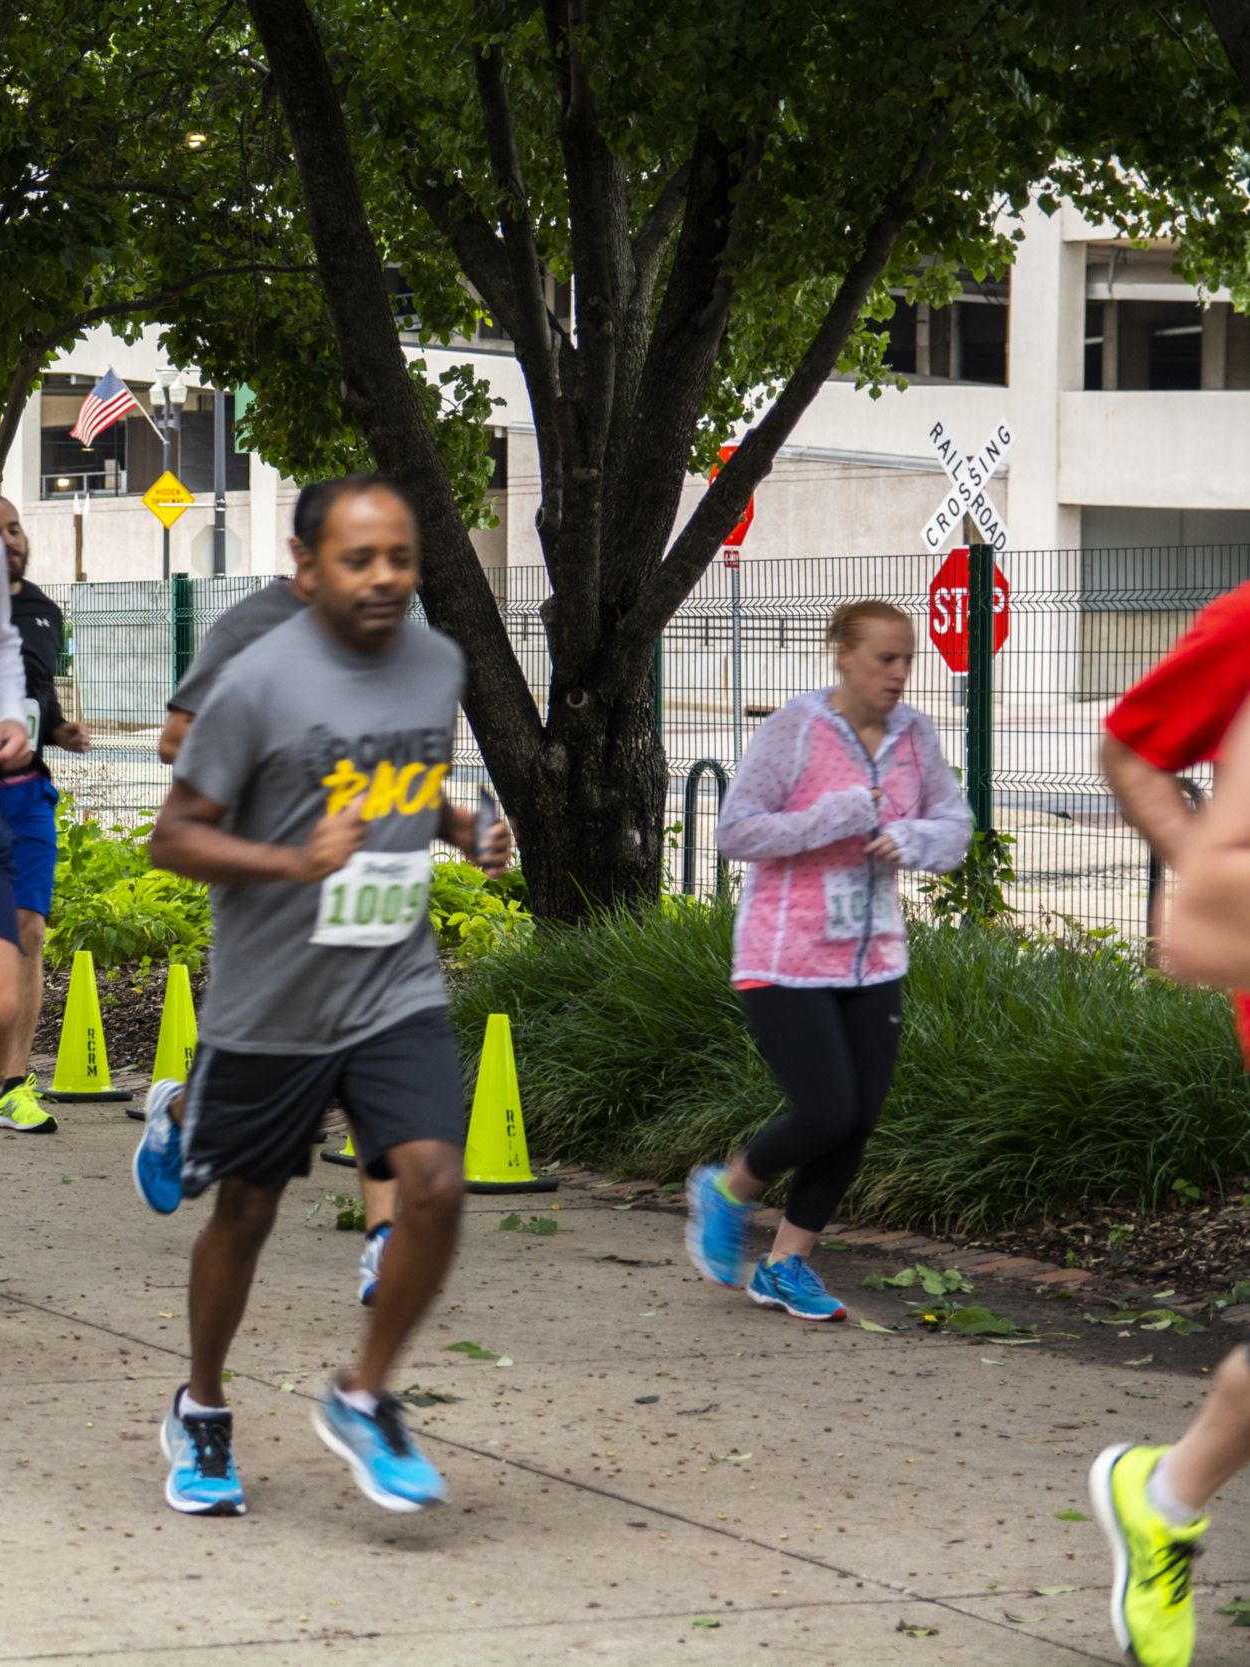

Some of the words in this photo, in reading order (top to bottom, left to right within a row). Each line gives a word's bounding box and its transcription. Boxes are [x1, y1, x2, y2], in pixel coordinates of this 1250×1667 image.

[926, 424, 1012, 548] CROSSING
[933, 587, 1005, 635] STP
[86, 1027, 98, 1077] RCRM
